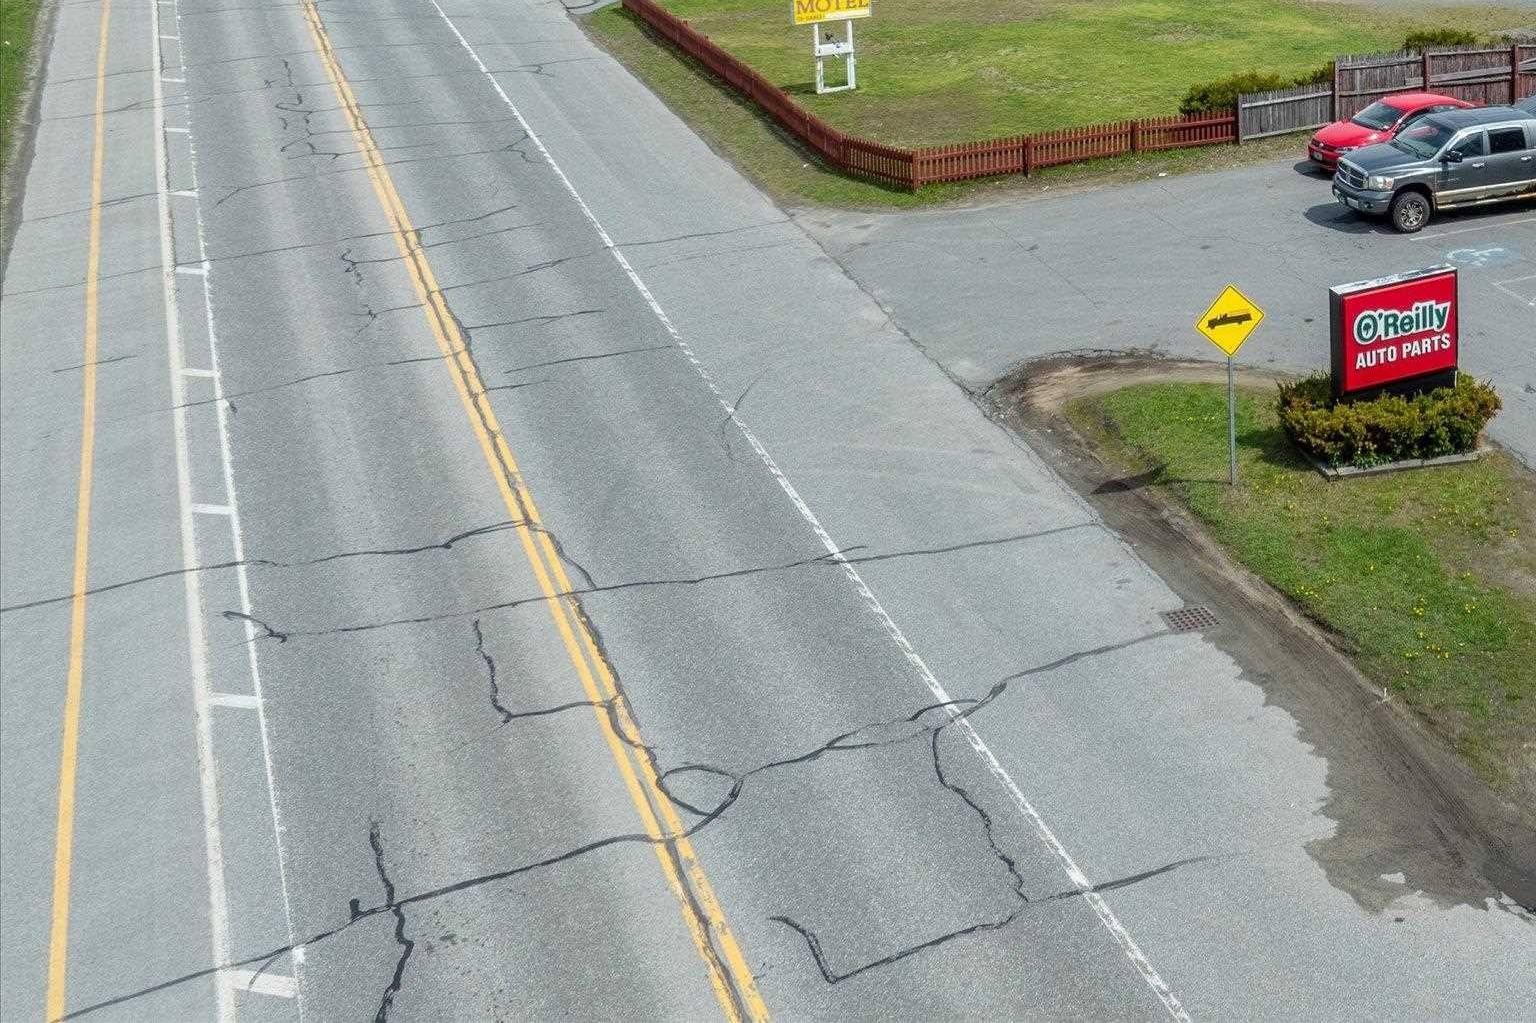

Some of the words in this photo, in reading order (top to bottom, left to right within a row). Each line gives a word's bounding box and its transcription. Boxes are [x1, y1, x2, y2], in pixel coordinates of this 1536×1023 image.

[1354, 300, 1450, 345] O'Reilly
[1355, 346, 1397, 369] AUTO
[1402, 333, 1450, 358] PARTS
